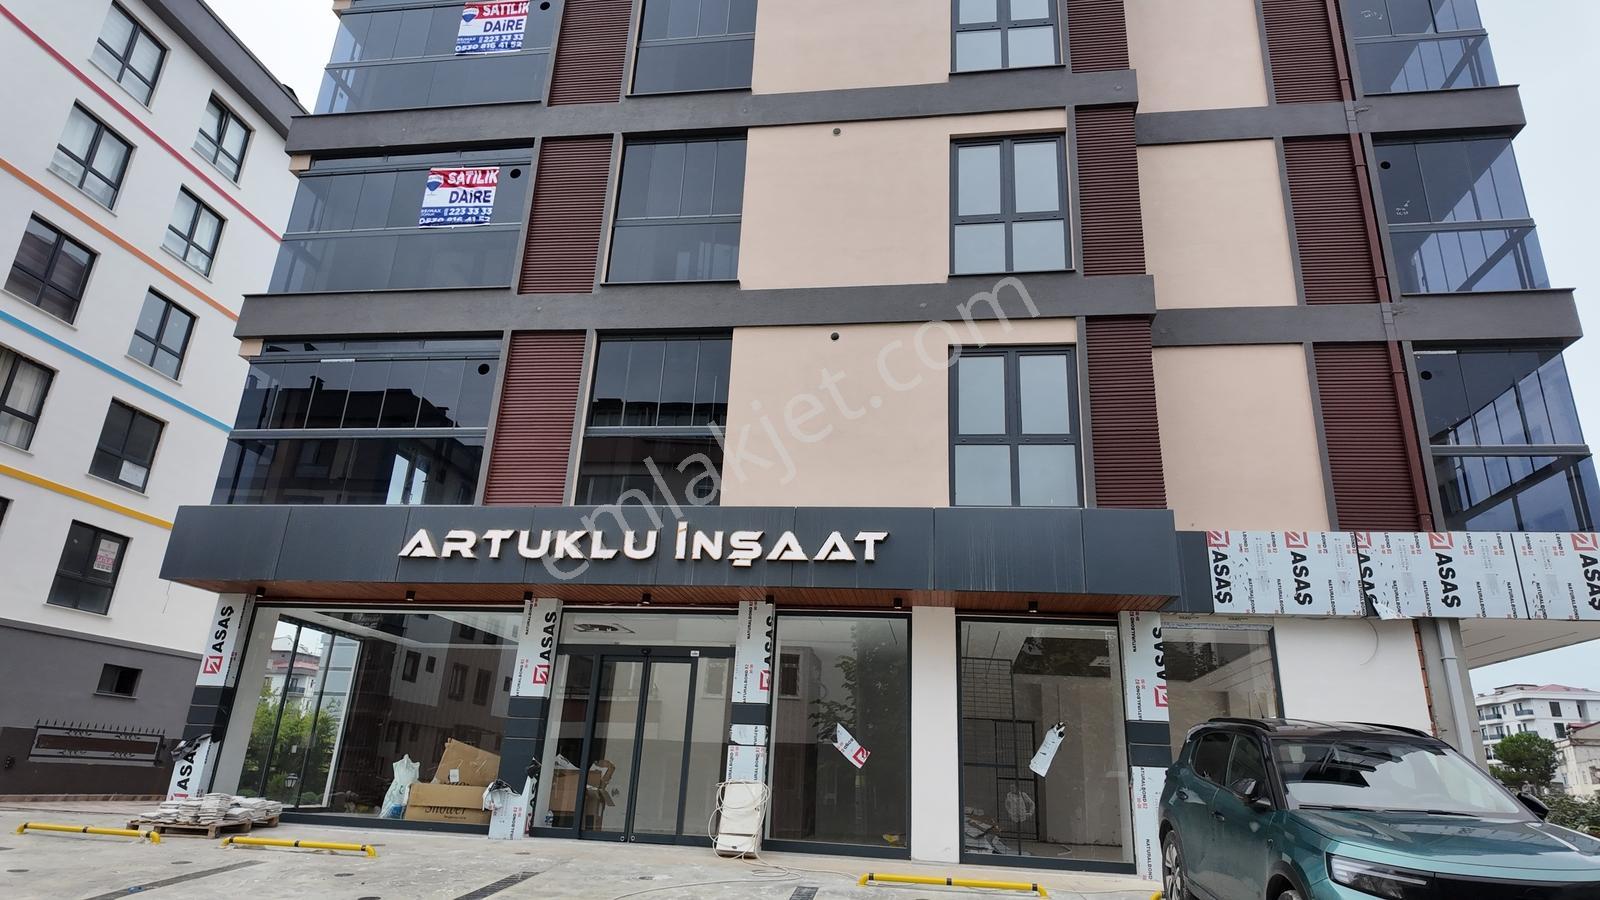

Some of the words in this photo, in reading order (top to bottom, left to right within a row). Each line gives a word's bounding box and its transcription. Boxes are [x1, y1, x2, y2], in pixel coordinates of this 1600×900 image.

[483, 2, 530, 16] SATILIK
[448, 170, 499, 184] SATILIK
[398, 528, 657, 560] ARTUKLU
[675, 520, 890, 567] İNŞAAT
[1211, 550, 1233, 604] ASAŞ
[1290, 551, 1313, 606] ASAŞ
[1435, 552, 1461, 608] ASAŞ
[212, 605, 234, 653] ASAŞ
